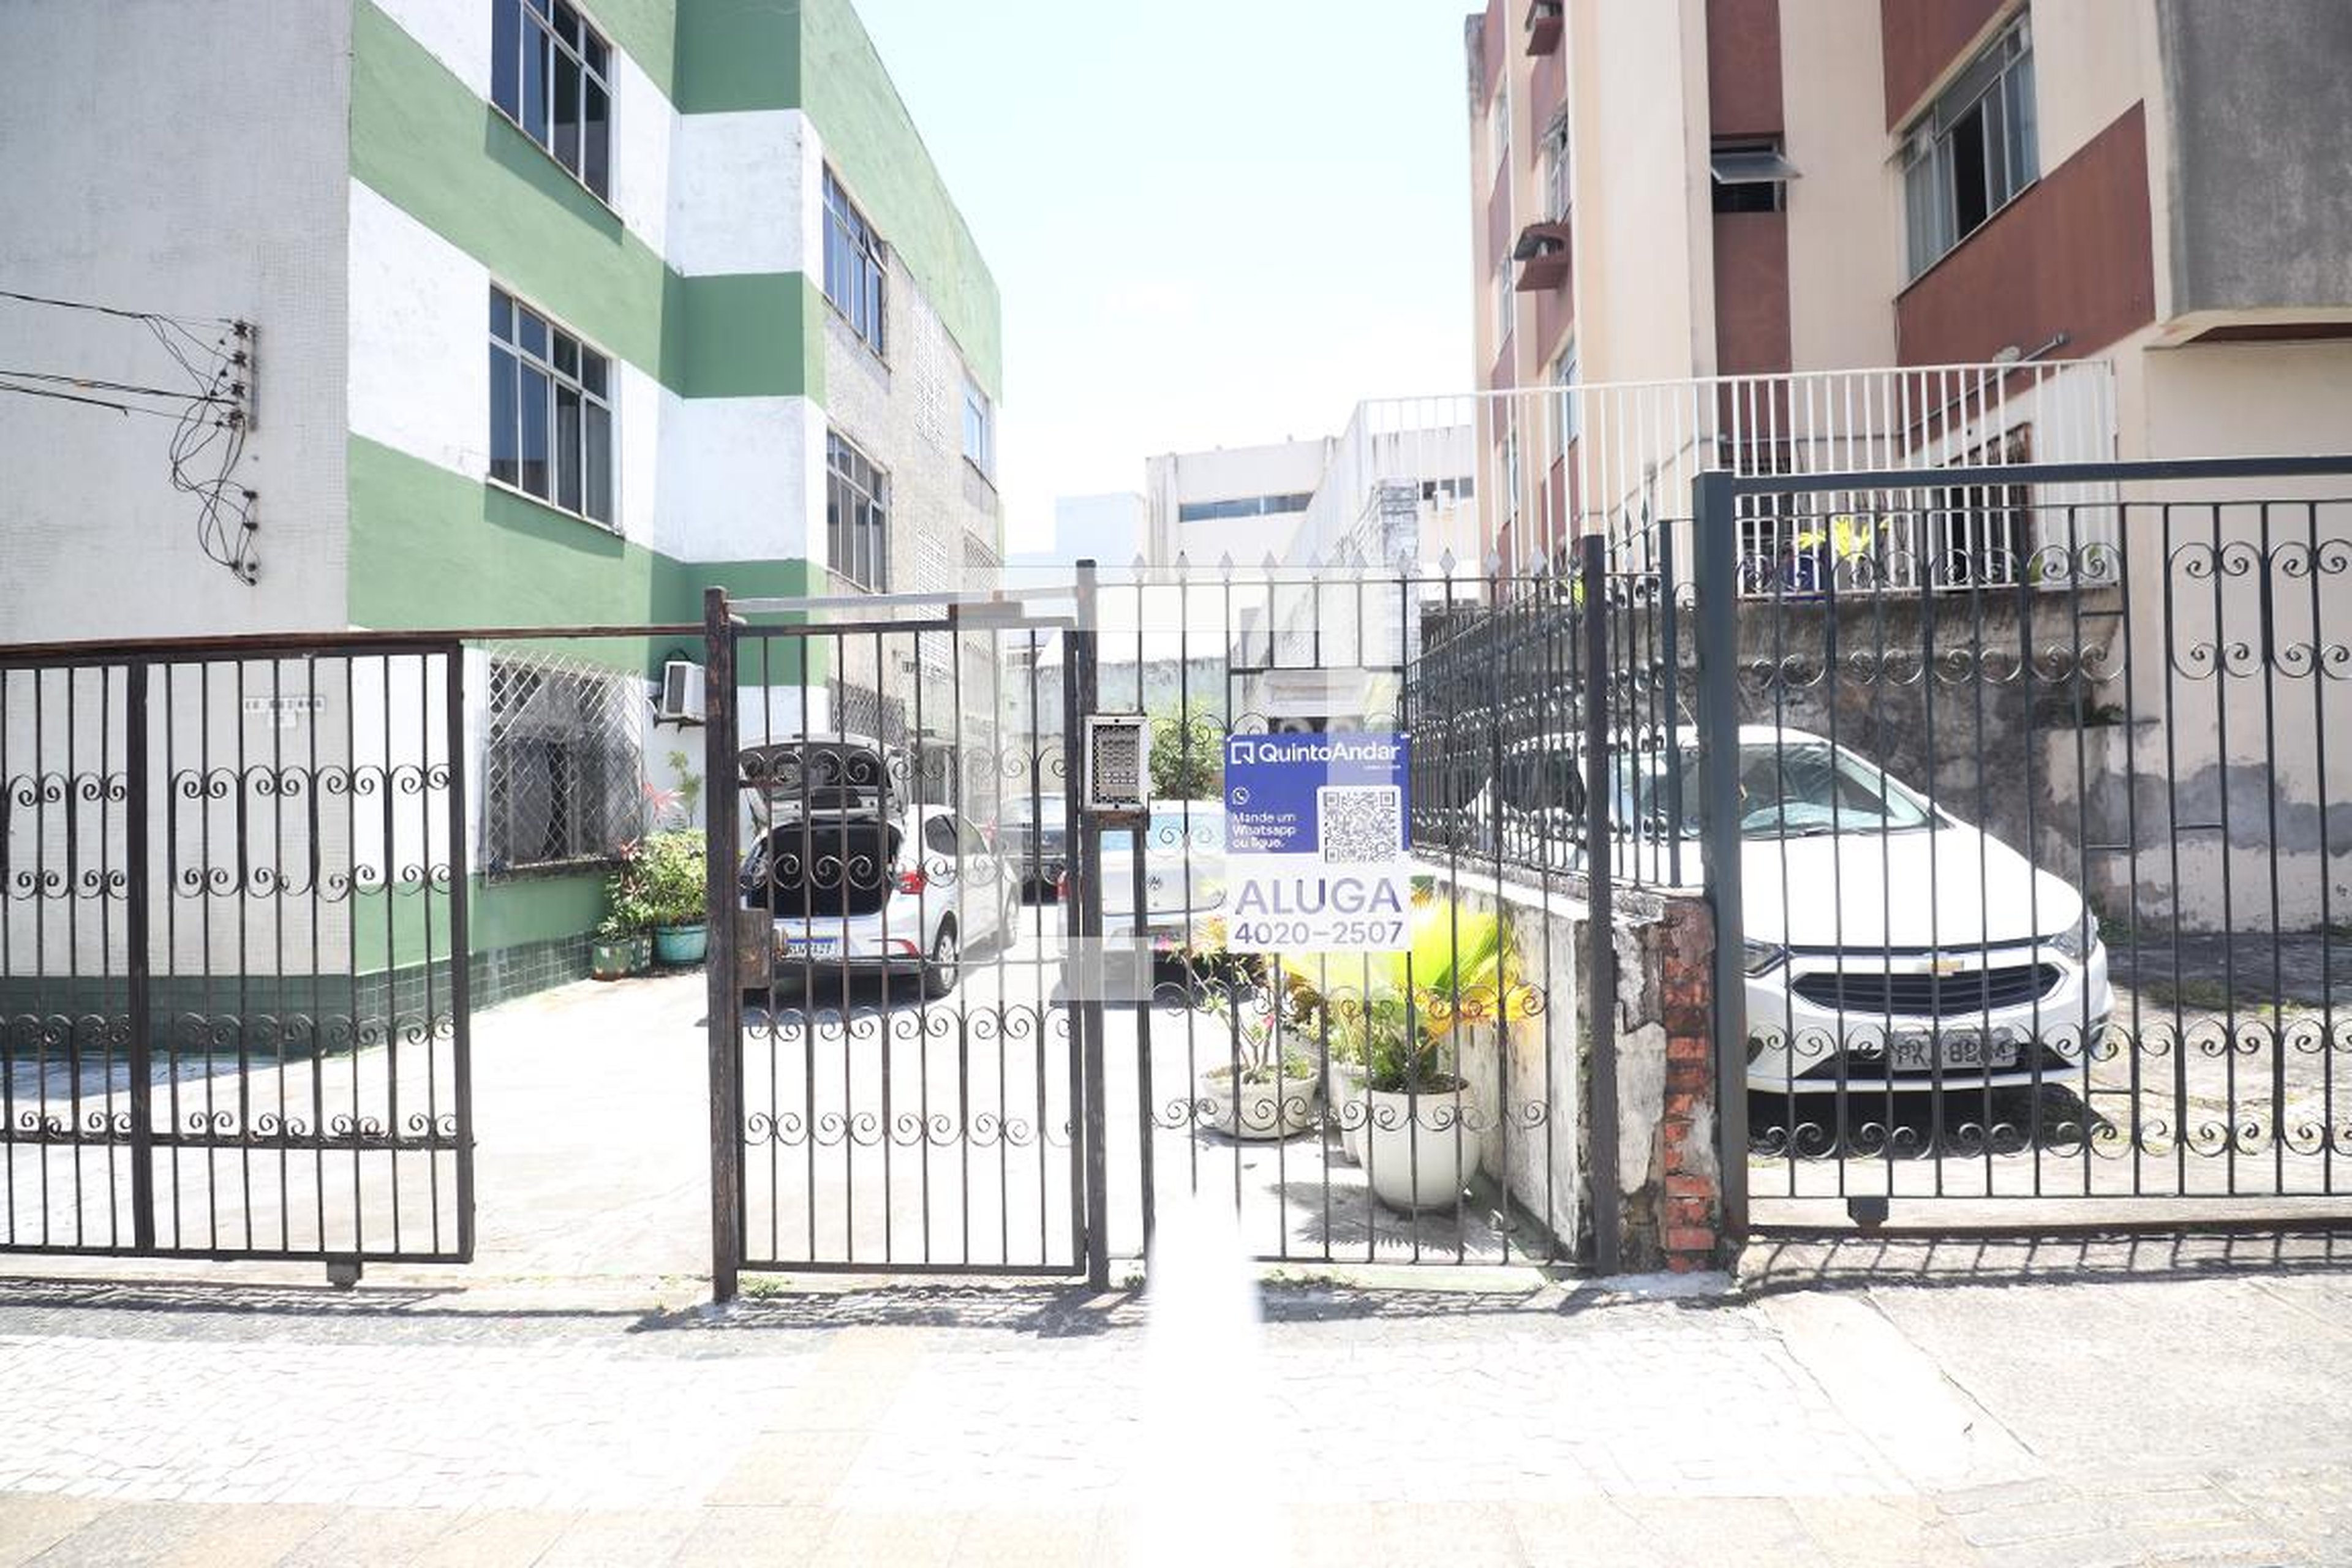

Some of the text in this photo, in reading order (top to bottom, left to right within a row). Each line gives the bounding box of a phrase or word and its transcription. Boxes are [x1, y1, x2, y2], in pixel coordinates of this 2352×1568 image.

[1259, 742, 1401, 763] QuintoAndar
[1235, 877, 1402, 915] ALUGA
[1235, 921, 1403, 944] 4020-2507
